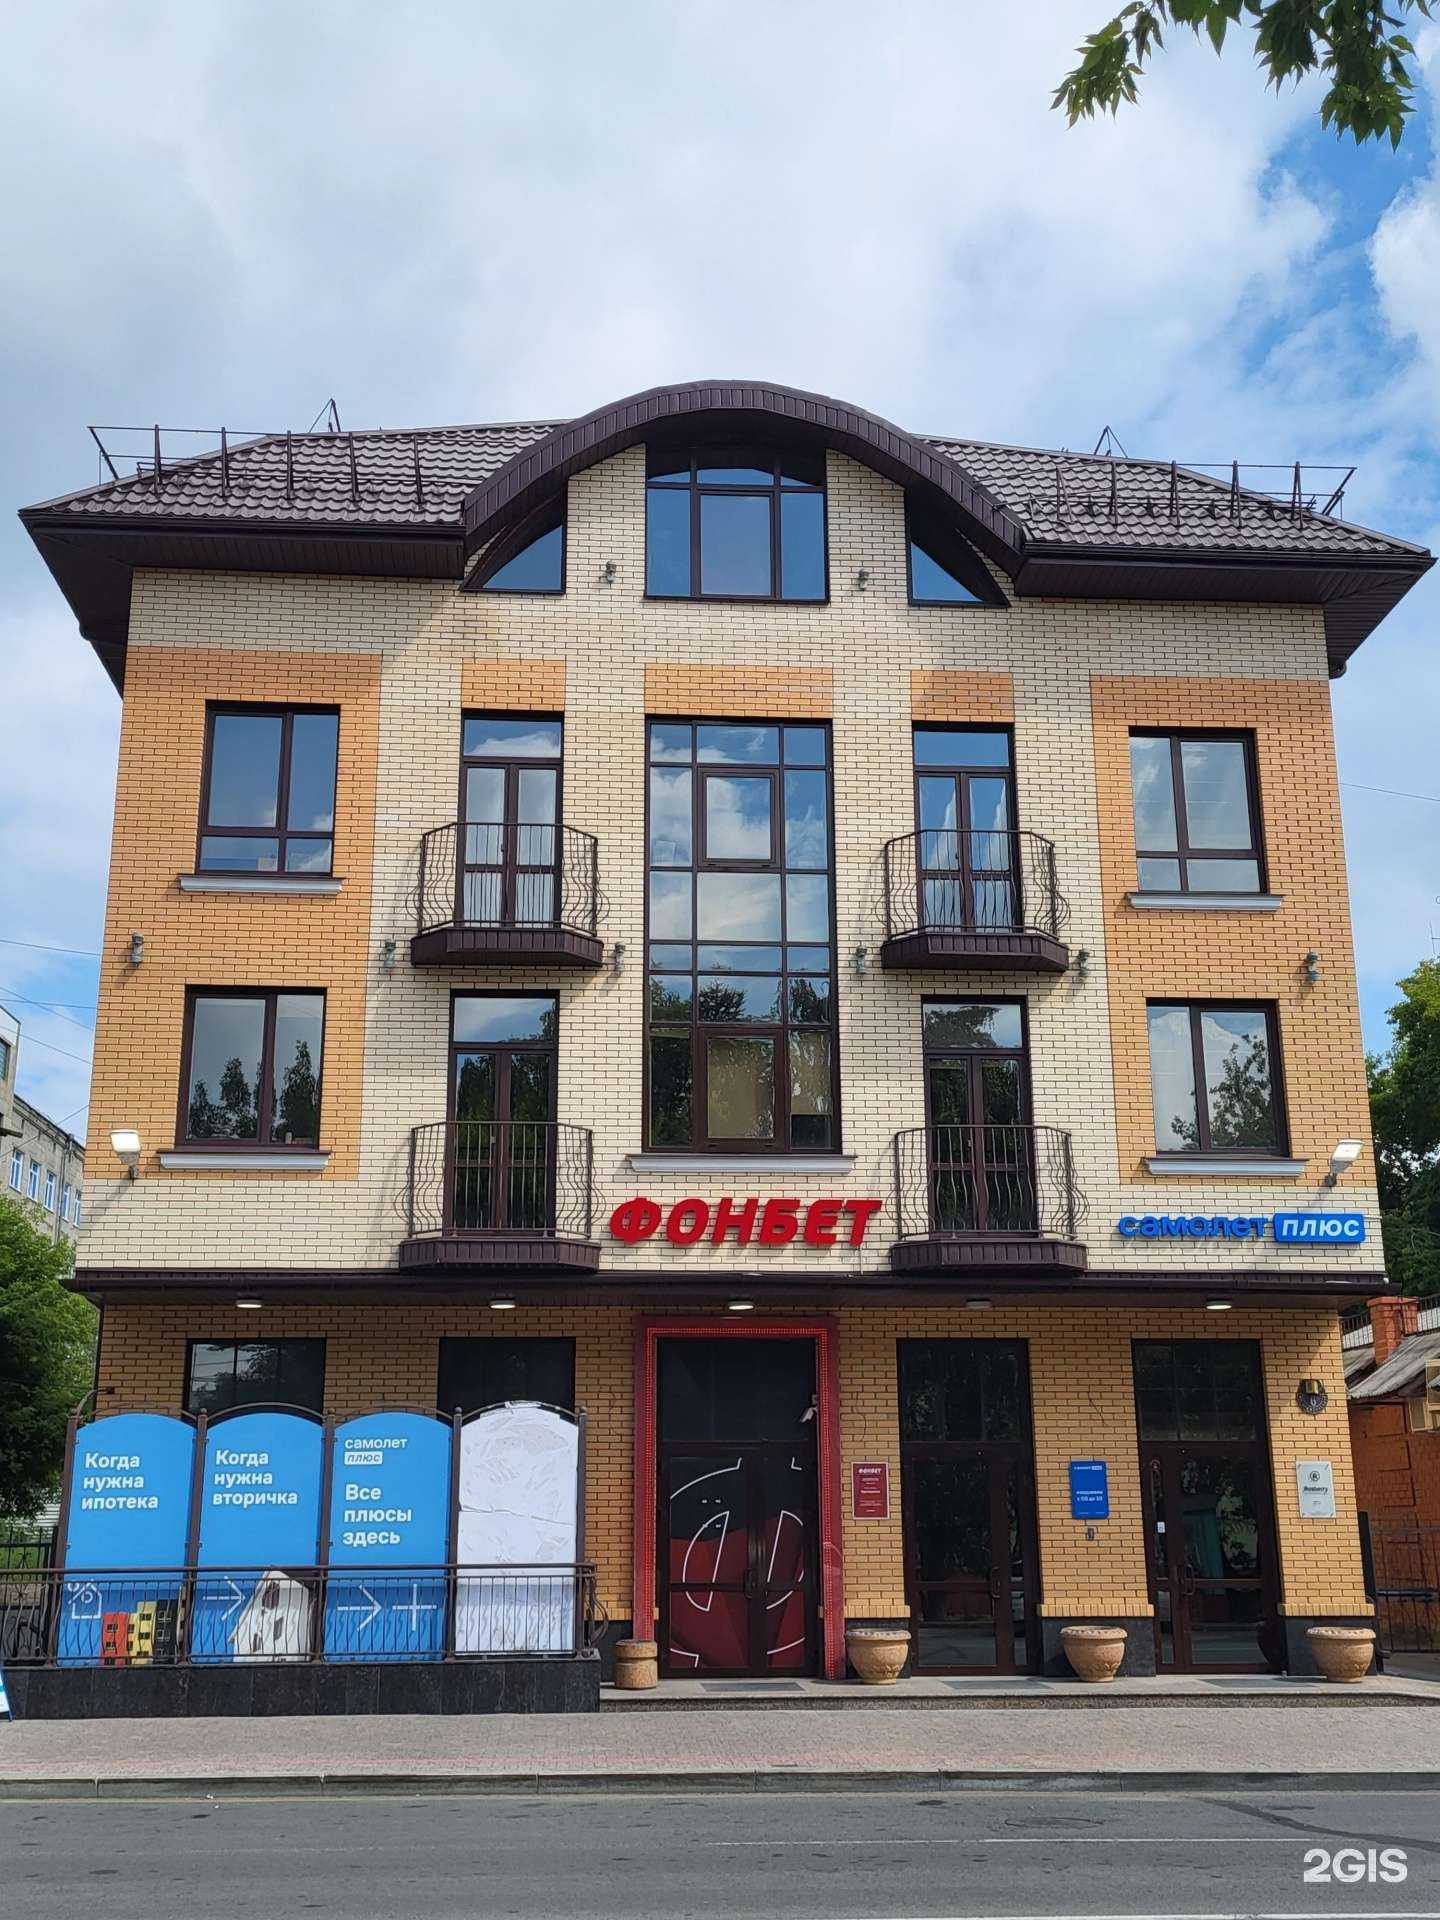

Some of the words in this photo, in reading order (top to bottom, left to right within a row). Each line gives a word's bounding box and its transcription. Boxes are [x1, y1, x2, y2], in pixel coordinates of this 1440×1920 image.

[609, 1198, 882, 1246] ФОНБЕТ
[1119, 1215, 1269, 1239] самолет
[1283, 1219, 1361, 1238] плюс
[345, 1439, 407, 1449] самолет
[85, 1452, 141, 1471] Когда
[215, 1450, 269, 1468] Когда
[346, 1453, 381, 1464] плюс
[83, 1475, 144, 1490] нужна
[214, 1473, 273, 1488] нужна
[212, 1491, 298, 1508] вторичка
[345, 1484, 381, 1500] Все
[81, 1495, 159, 1510] ипотека
[344, 1509, 412, 1523] плюсы
[343, 1531, 401, 1547] здесь
